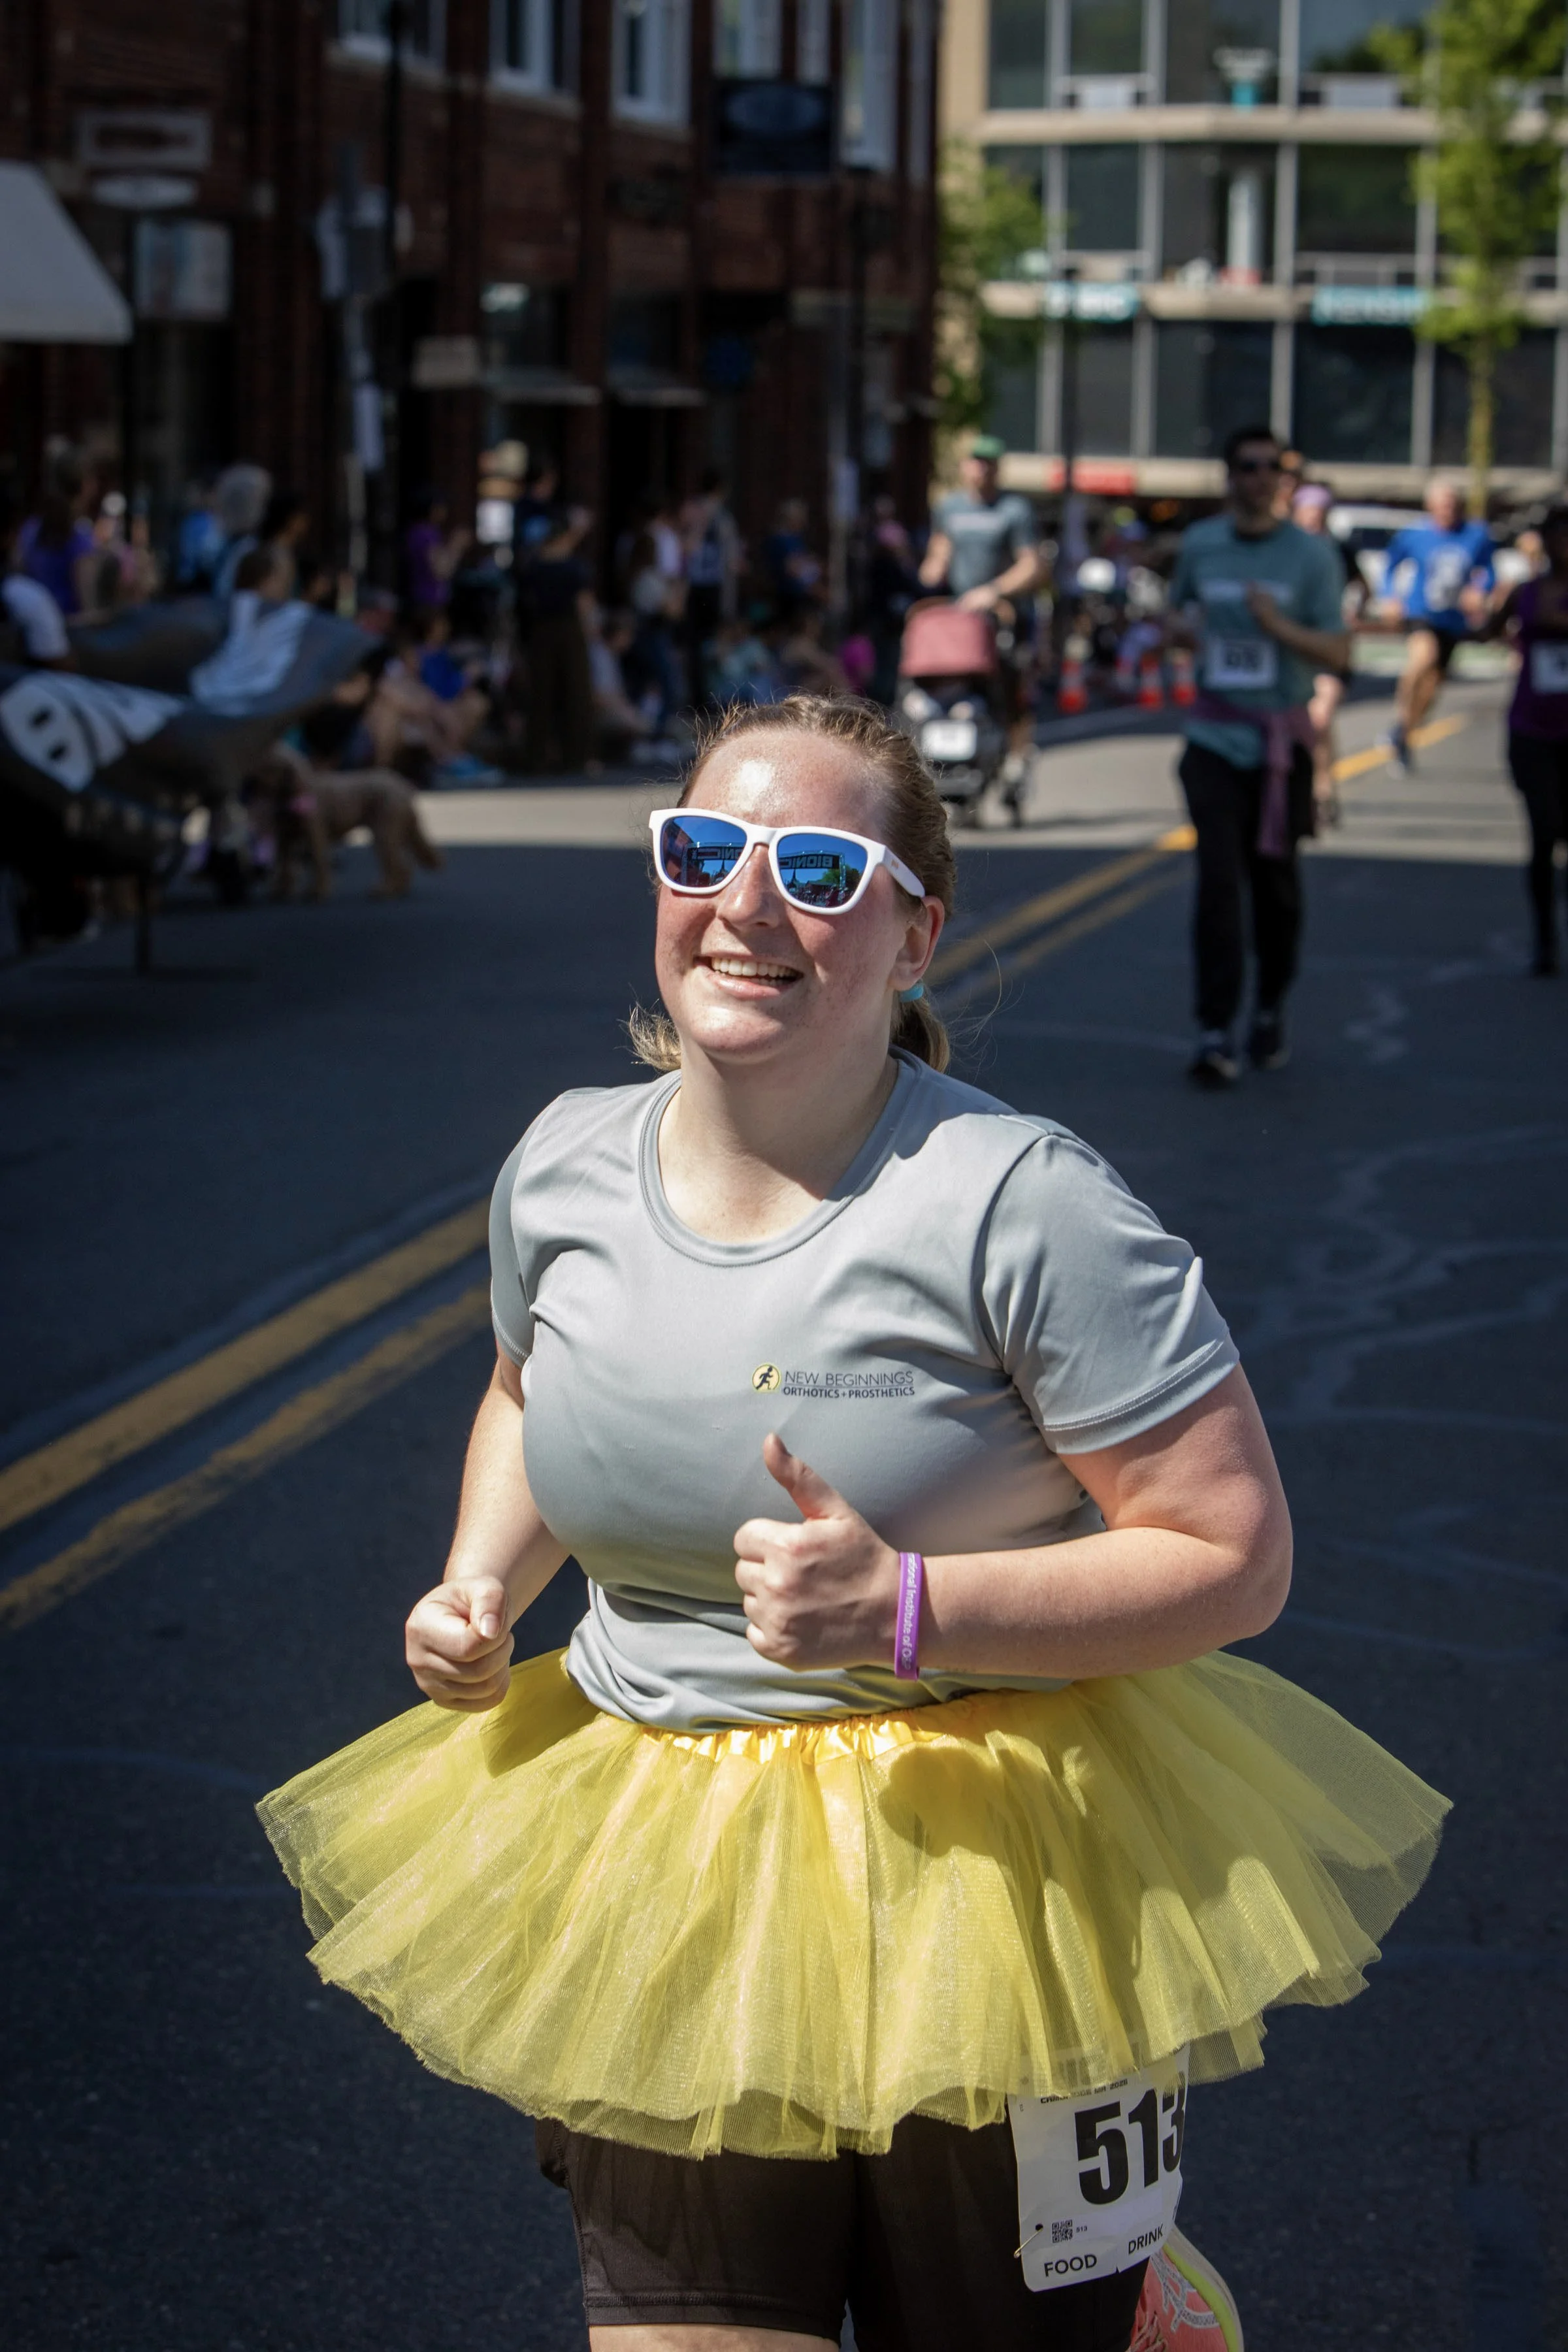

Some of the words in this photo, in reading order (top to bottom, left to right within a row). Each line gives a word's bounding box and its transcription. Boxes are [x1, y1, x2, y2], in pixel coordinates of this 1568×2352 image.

[783, 1387, 840, 1399] ORTHOTICS
[849, 1386, 915, 1399] PROSTHETICS
[785, 1371, 819, 1384] NEW
[826, 1371, 913, 1386] BEGINNINGS
[1074, 2078, 1185, 2205] 513
[1044, 2253, 1098, 2278] FOOD
[1128, 2223, 1164, 2255] DRINK
